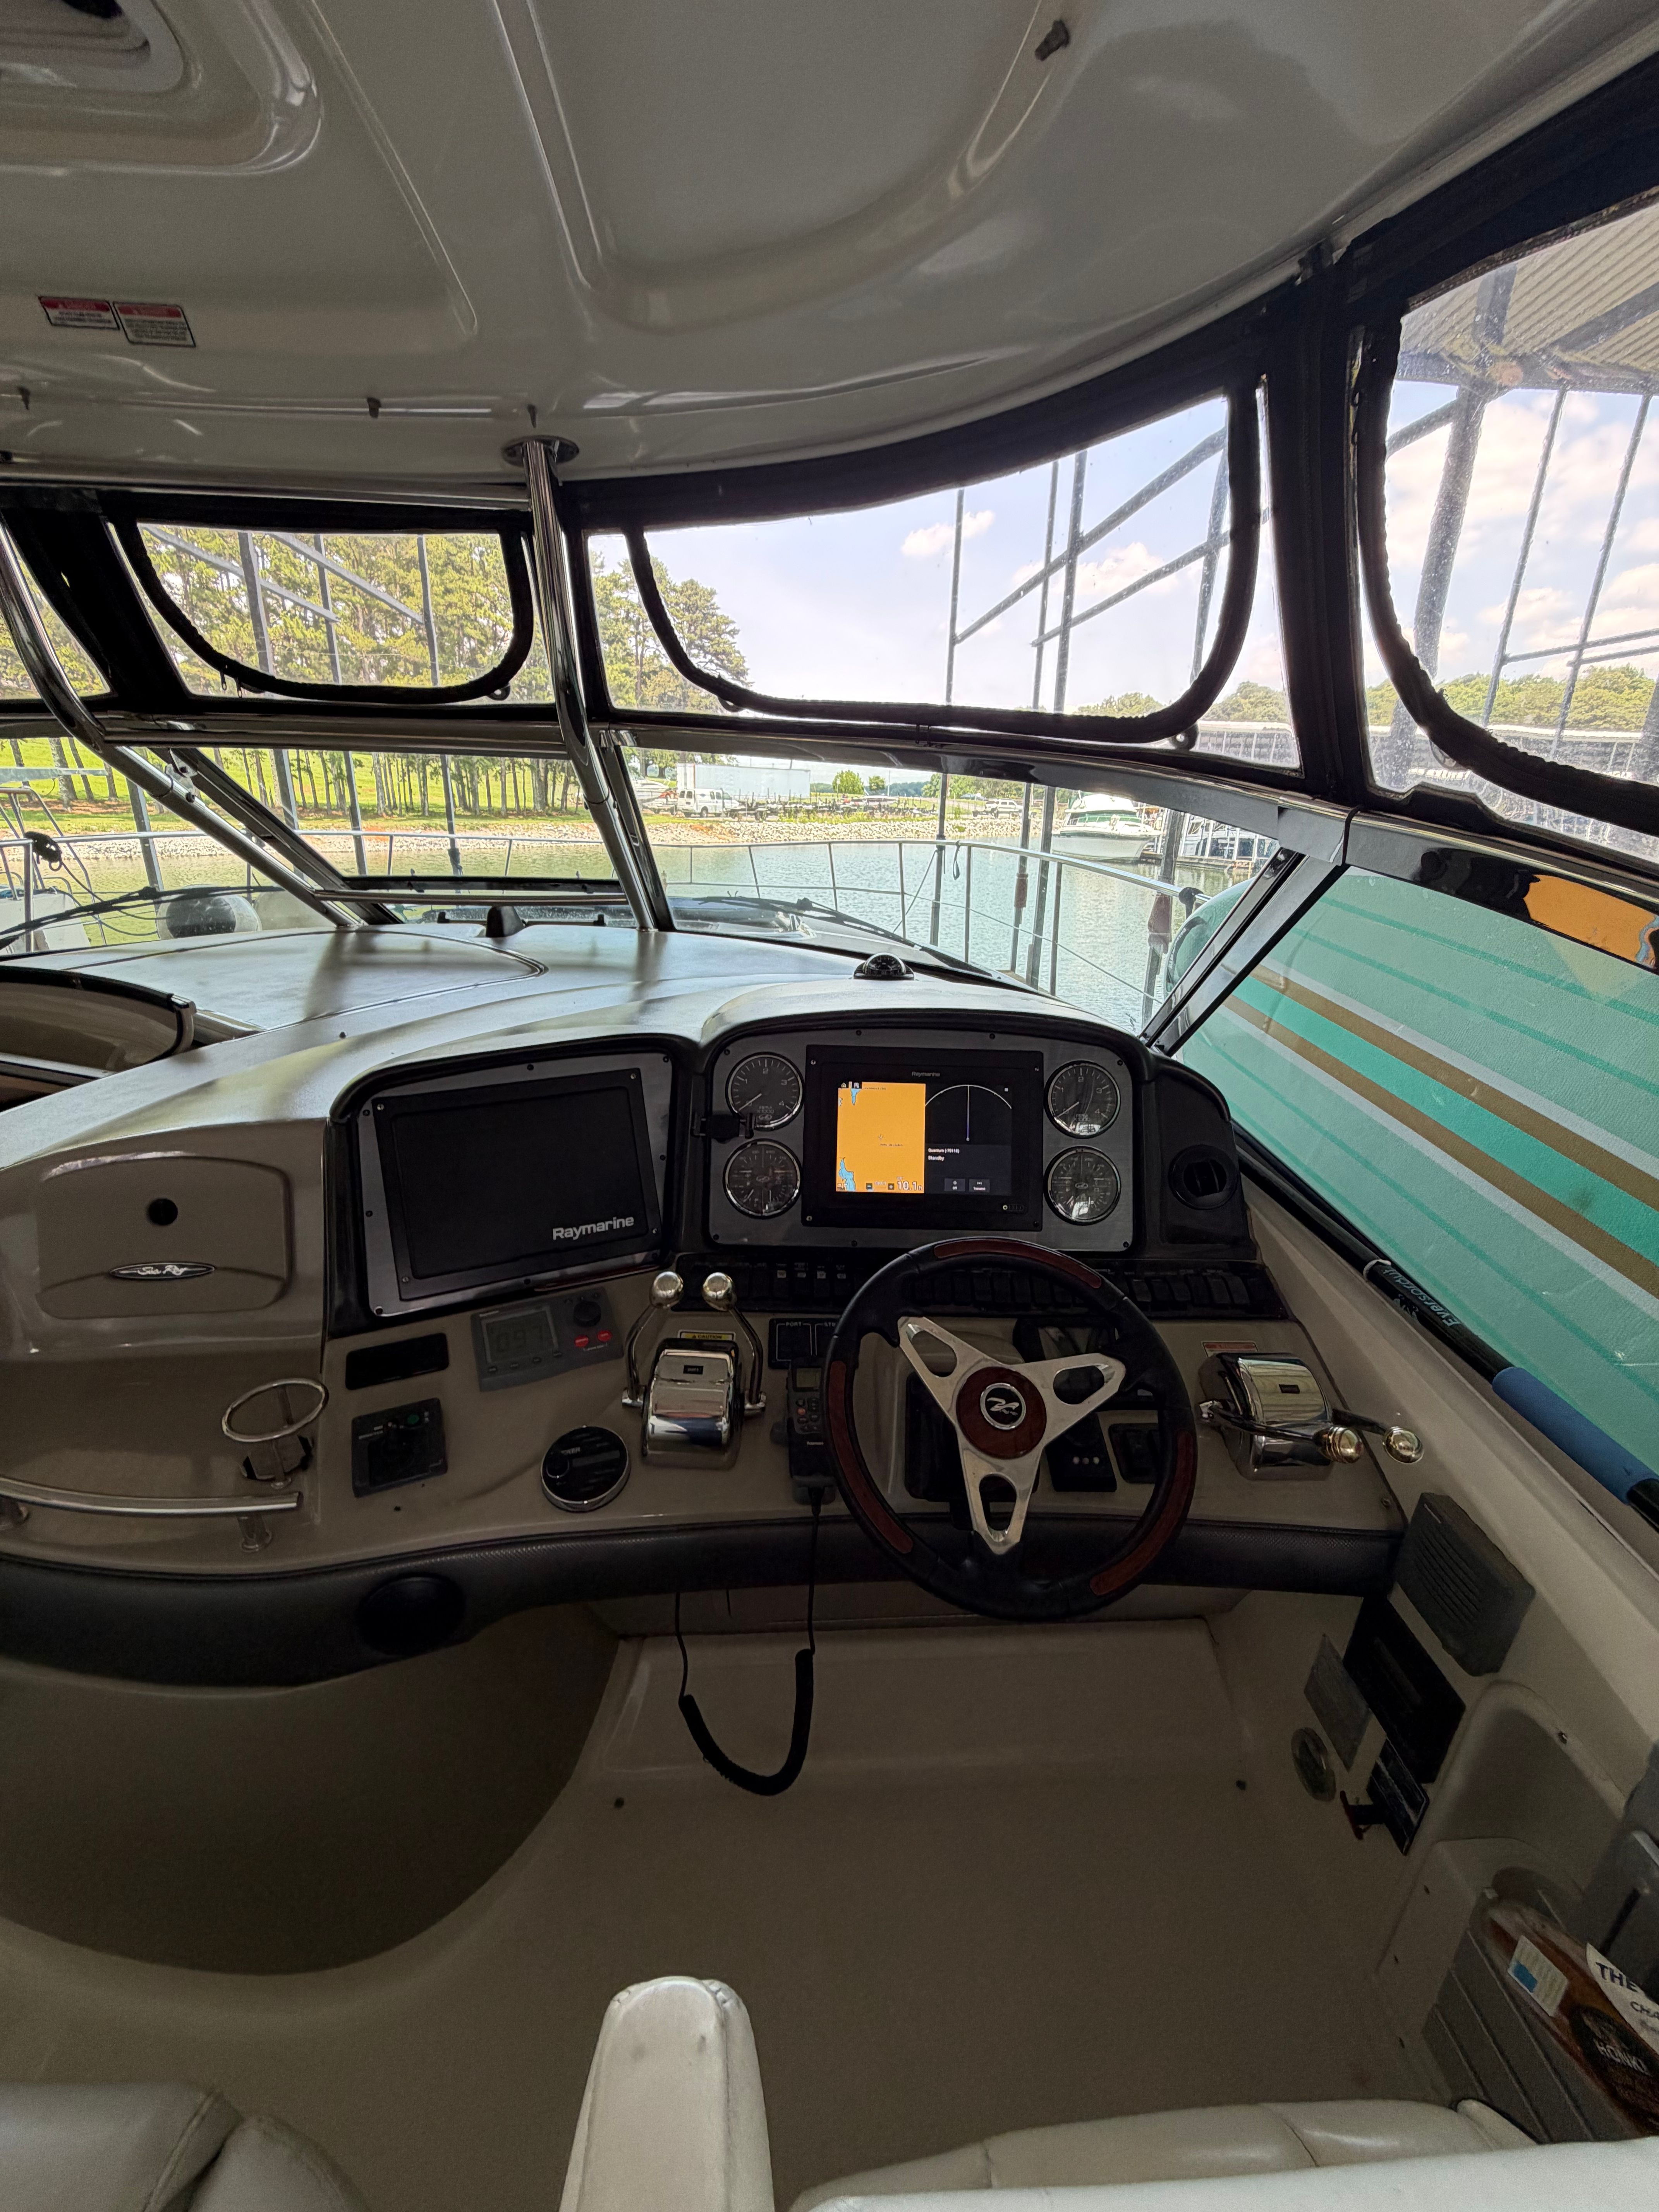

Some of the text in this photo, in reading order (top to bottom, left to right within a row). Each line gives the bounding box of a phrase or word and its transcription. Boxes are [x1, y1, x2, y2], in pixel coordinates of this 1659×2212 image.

[896, 1180, 917, 1191] 10.1
[553, 1216, 634, 1240] Raymarine
[137, 1264, 188, 1276] Sea Ray
